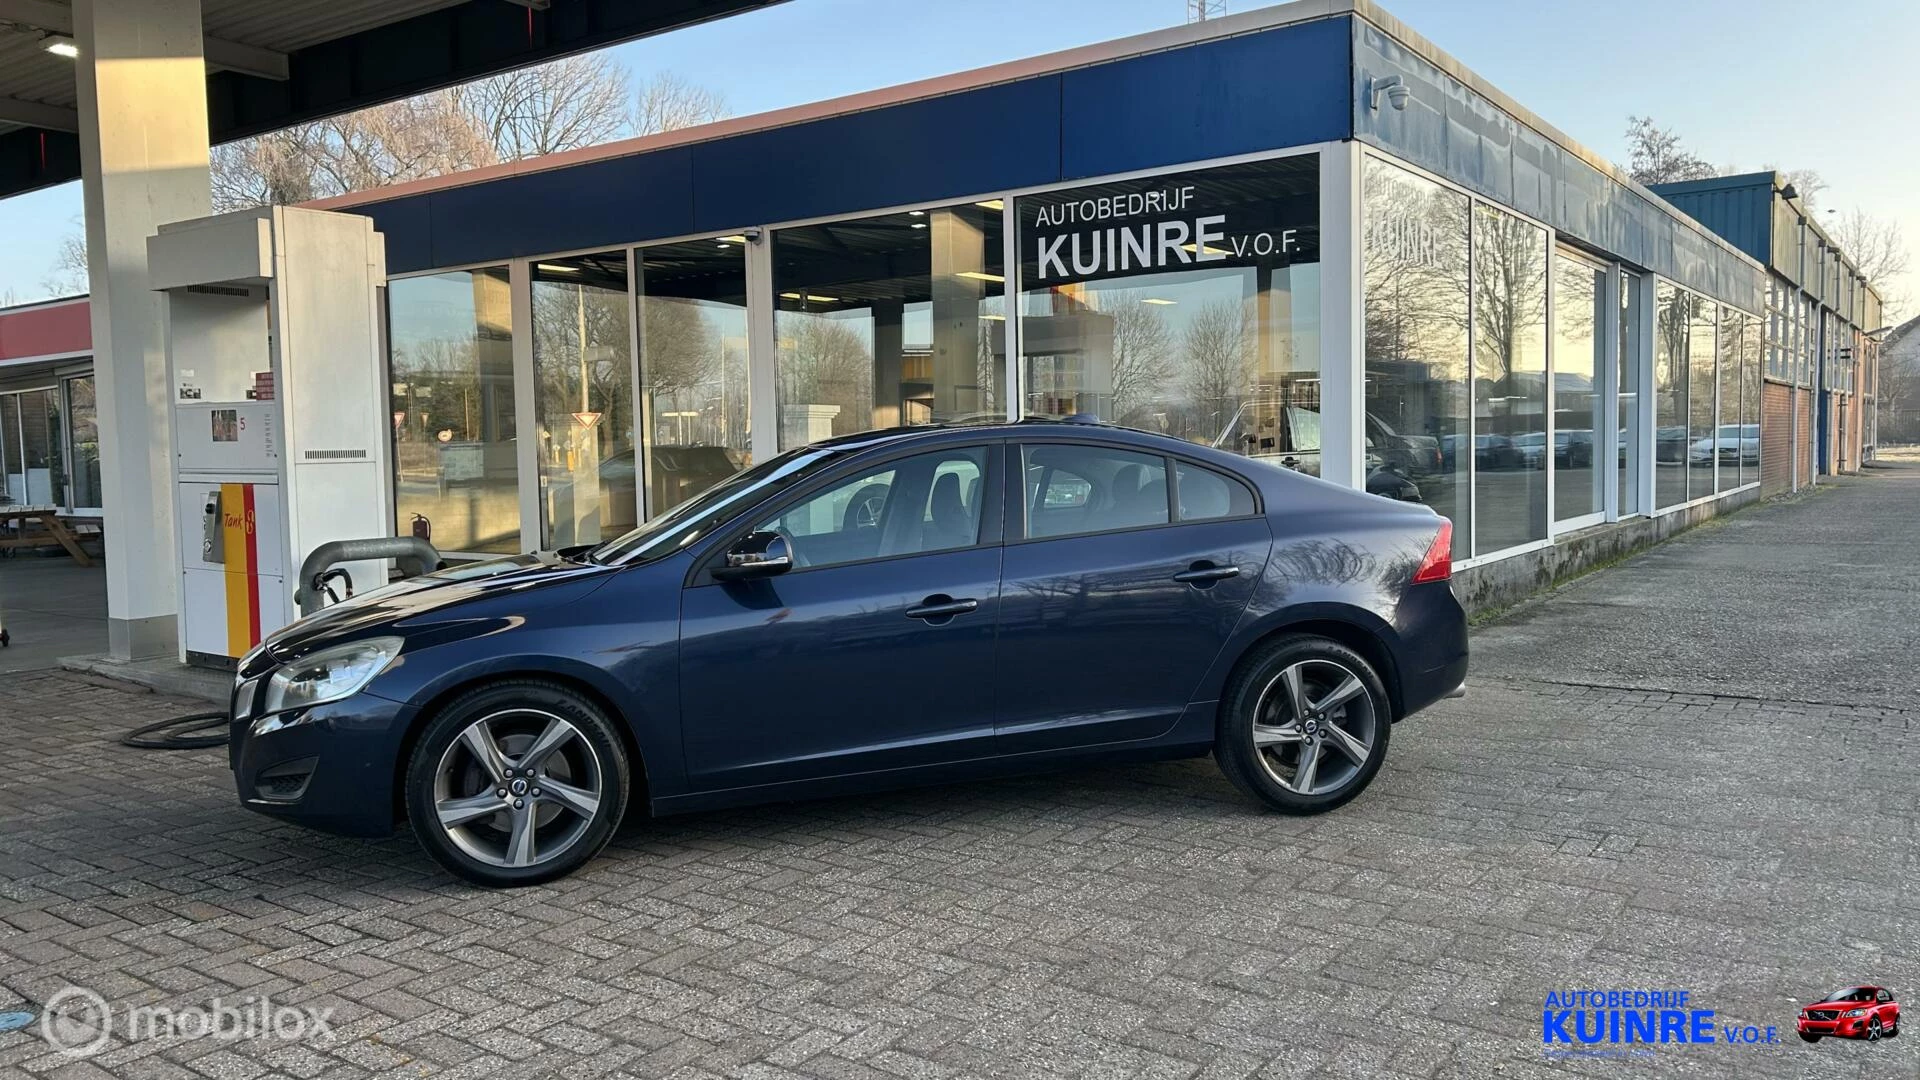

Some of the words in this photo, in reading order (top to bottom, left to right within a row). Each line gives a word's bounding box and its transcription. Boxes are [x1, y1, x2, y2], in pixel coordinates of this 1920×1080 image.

[1035, 186, 1196, 228] AUTOBEDRIJF
[1037, 215, 1228, 279] KUINRE
[1231, 229, 1301, 259] V.O.F.
[239, 417, 246, 431] 5
[224, 512, 243, 530] Tank
